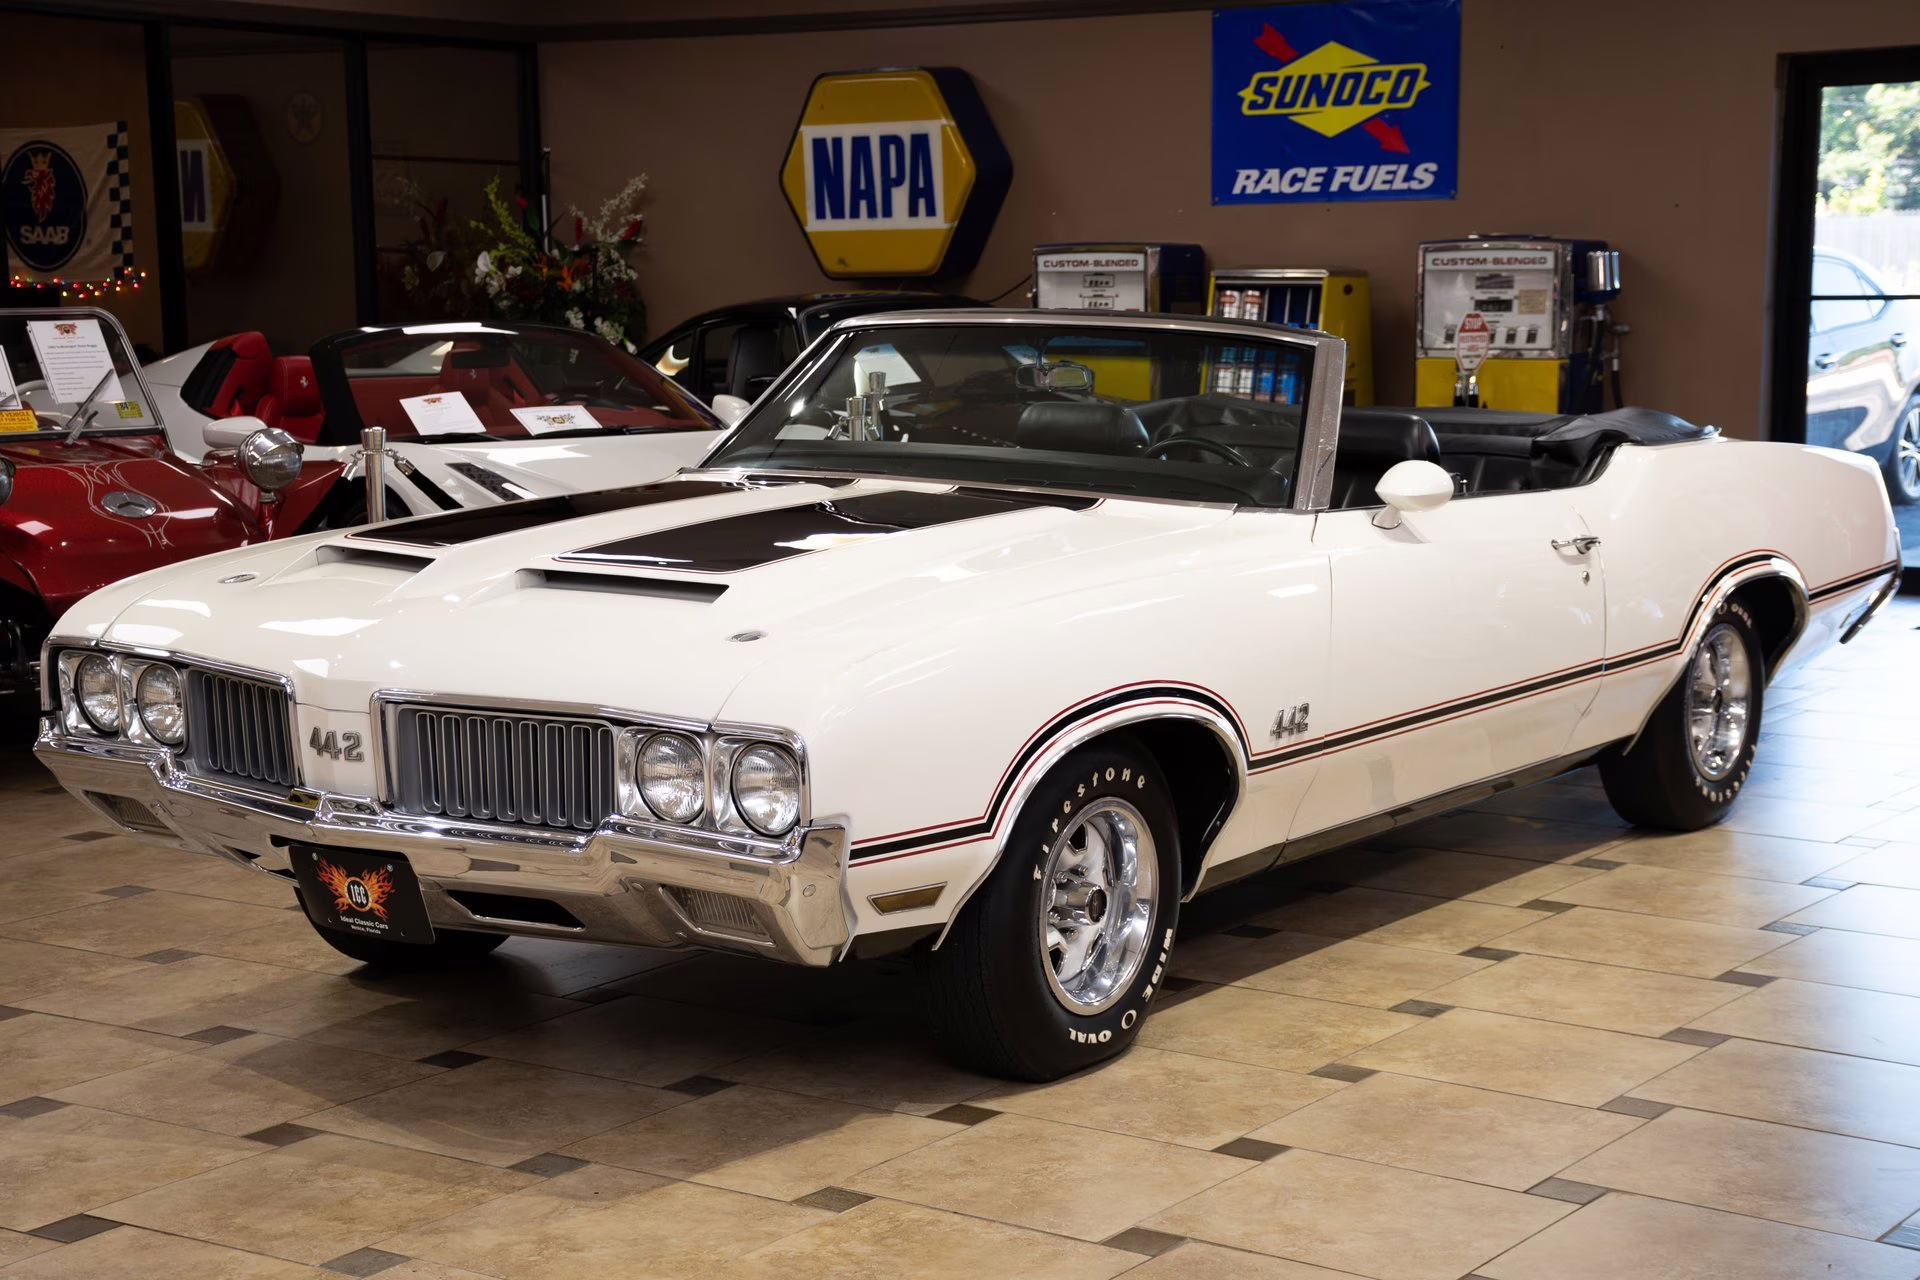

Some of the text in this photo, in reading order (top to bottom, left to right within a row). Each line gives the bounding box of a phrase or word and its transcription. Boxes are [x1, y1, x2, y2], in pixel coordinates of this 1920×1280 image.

[1247, 68, 1421, 111] SUNOCO
[812, 133, 936, 220] NAPA
[1232, 162, 1438, 194] RACE FUELS
[20, 225, 69, 245] SAAB
[1043, 259, 1138, 268] CUSTOM-BLENDED
[1432, 257, 1548, 266] CUSTOM-BLENDED
[1270, 702, 1310, 739] 442
[309, 726, 364, 762] 442
[350, 884, 367, 905] ICC
[340, 915, 389, 930] Ideal Classic Cars
[1142, 928, 1173, 1003] WIDE
[1068, 1027, 1112, 1044] OVAL
